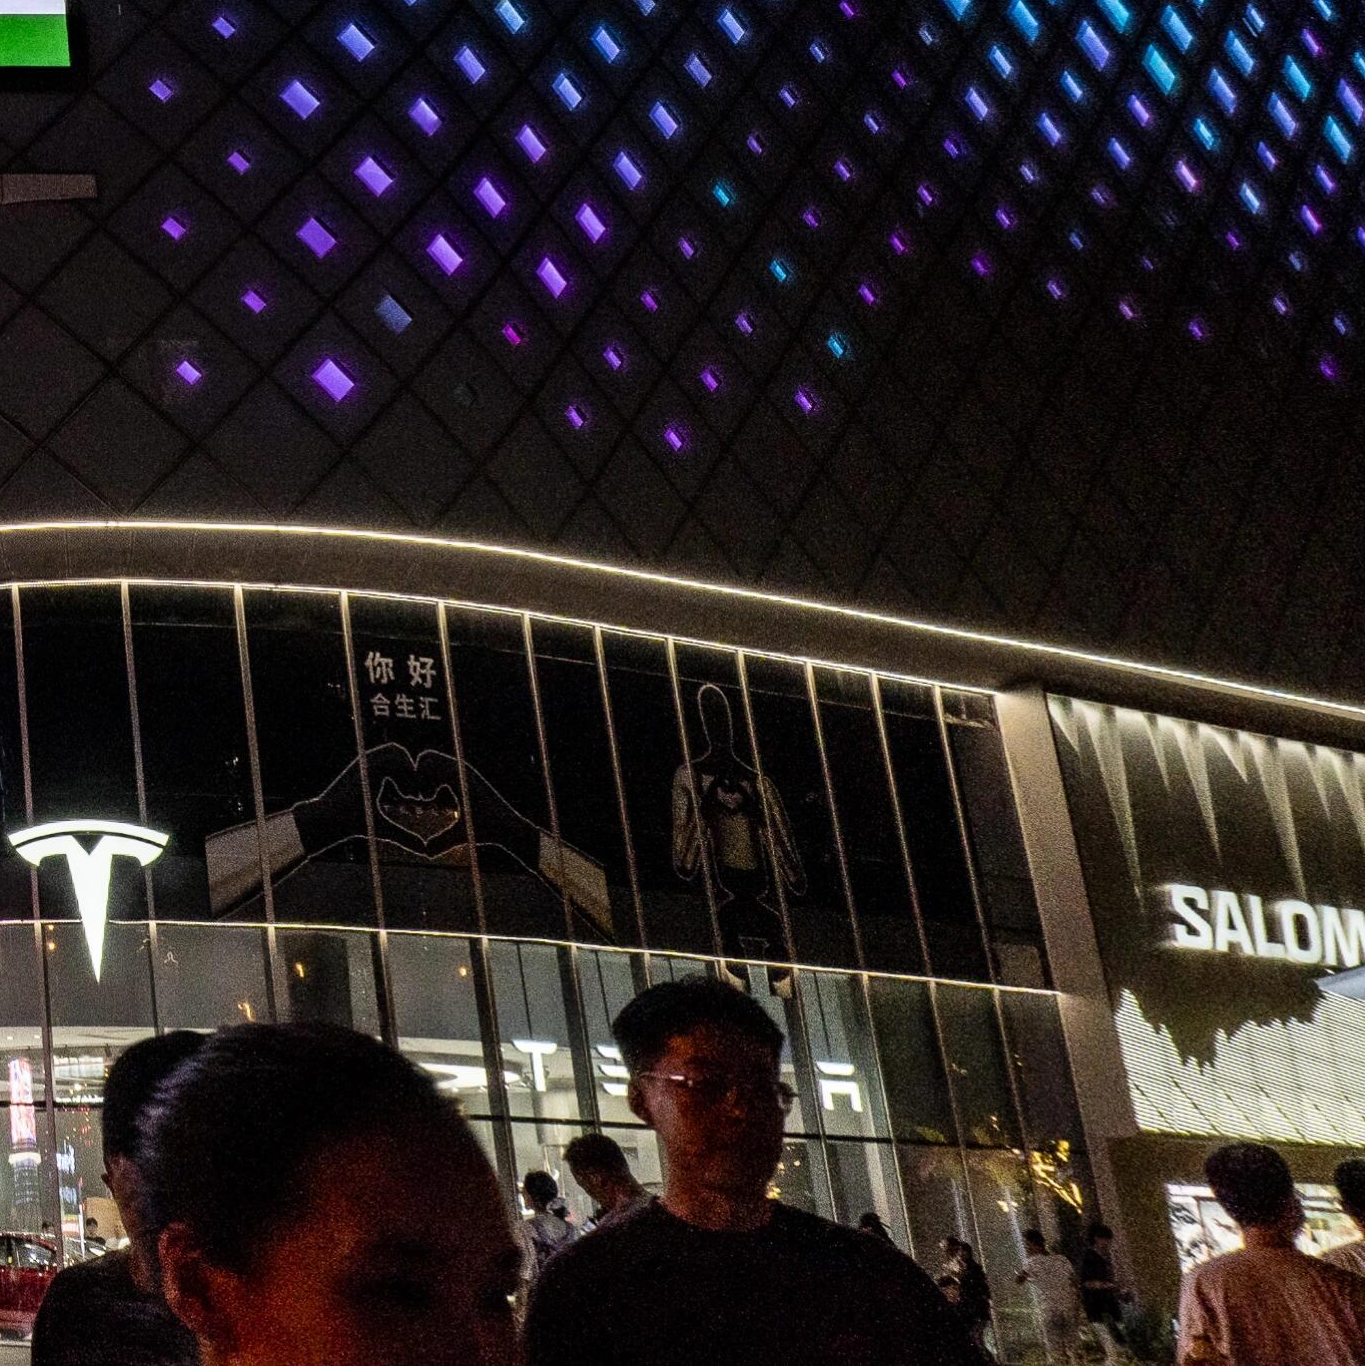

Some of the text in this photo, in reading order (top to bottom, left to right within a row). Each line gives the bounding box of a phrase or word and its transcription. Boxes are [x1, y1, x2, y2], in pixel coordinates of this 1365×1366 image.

[364, 650, 437, 689] 你好
[370, 692, 442, 721] 合生汇
